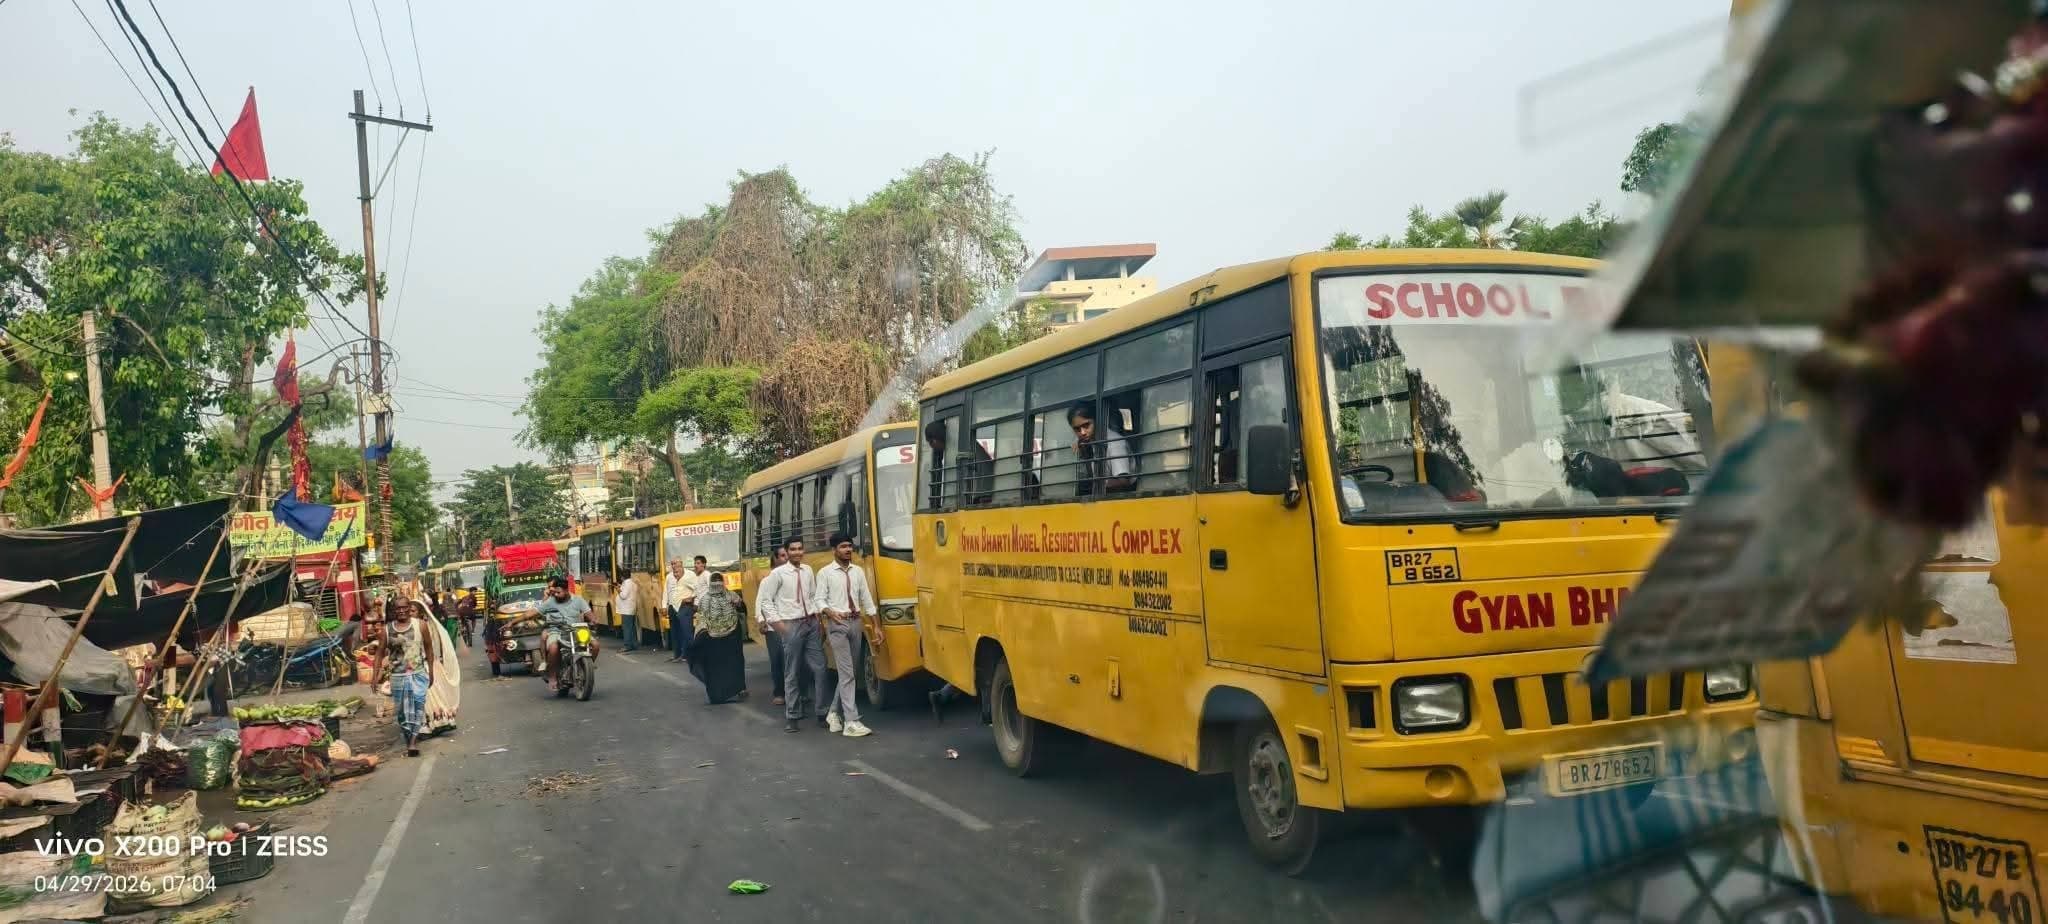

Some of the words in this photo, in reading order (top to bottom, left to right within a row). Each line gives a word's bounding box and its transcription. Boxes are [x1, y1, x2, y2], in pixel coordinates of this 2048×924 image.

[1365, 282, 1552, 320] SCHOOL
[674, 524, 718, 537] SCHOOL
[722, 522, 739, 533] BU
[961, 526, 980, 553] GYAN
[981, 525, 1010, 553] BHARTI
[1011, 522, 1040, 553] MODEL
[1041, 522, 1108, 553] RESIDENTIAL
[1111, 519, 1182, 555] COMPLEX
[1391, 552, 1432, 568] BR27
[1453, 589, 1555, 634] GYAN
